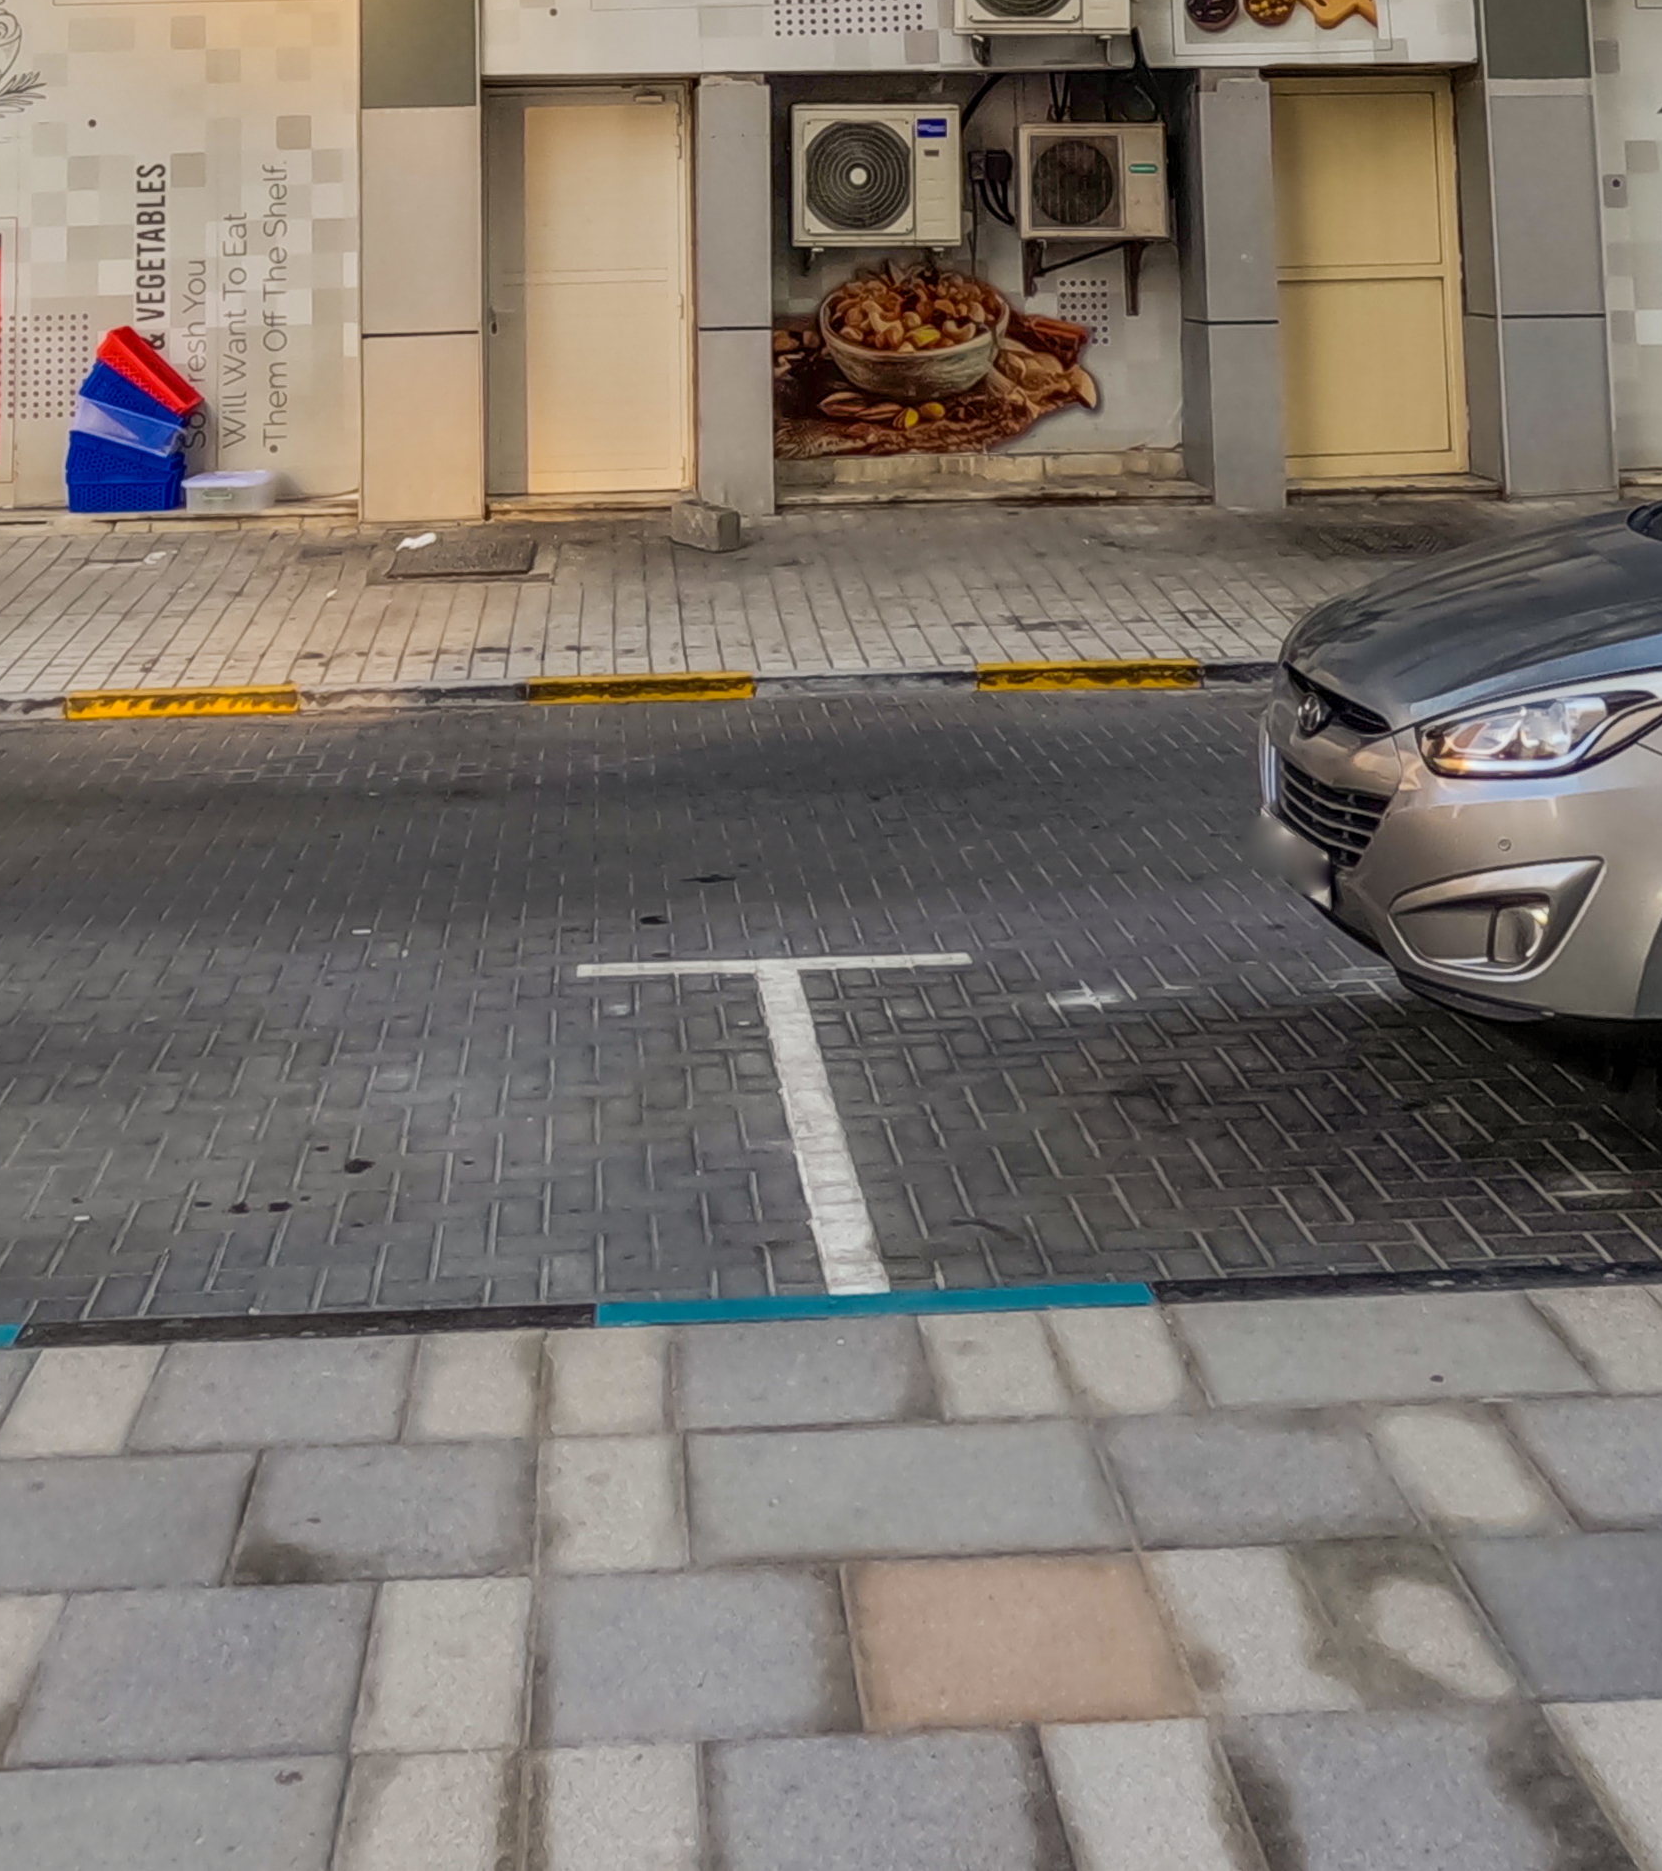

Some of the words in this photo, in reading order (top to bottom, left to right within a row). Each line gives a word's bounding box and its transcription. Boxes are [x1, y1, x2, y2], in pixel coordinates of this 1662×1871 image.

[136, 163, 166, 322] VEGETABLES
[223, 212, 247, 258] Eat
[182, 259, 207, 315] You
[222, 267, 247, 302] To
[263, 247, 288, 303] The
[182, 321, 207, 383] resh
[223, 309, 247, 387] Want
[263, 313, 288, 352] Off
[222, 390, 247, 450] Will
[263, 362, 288, 448] Them
